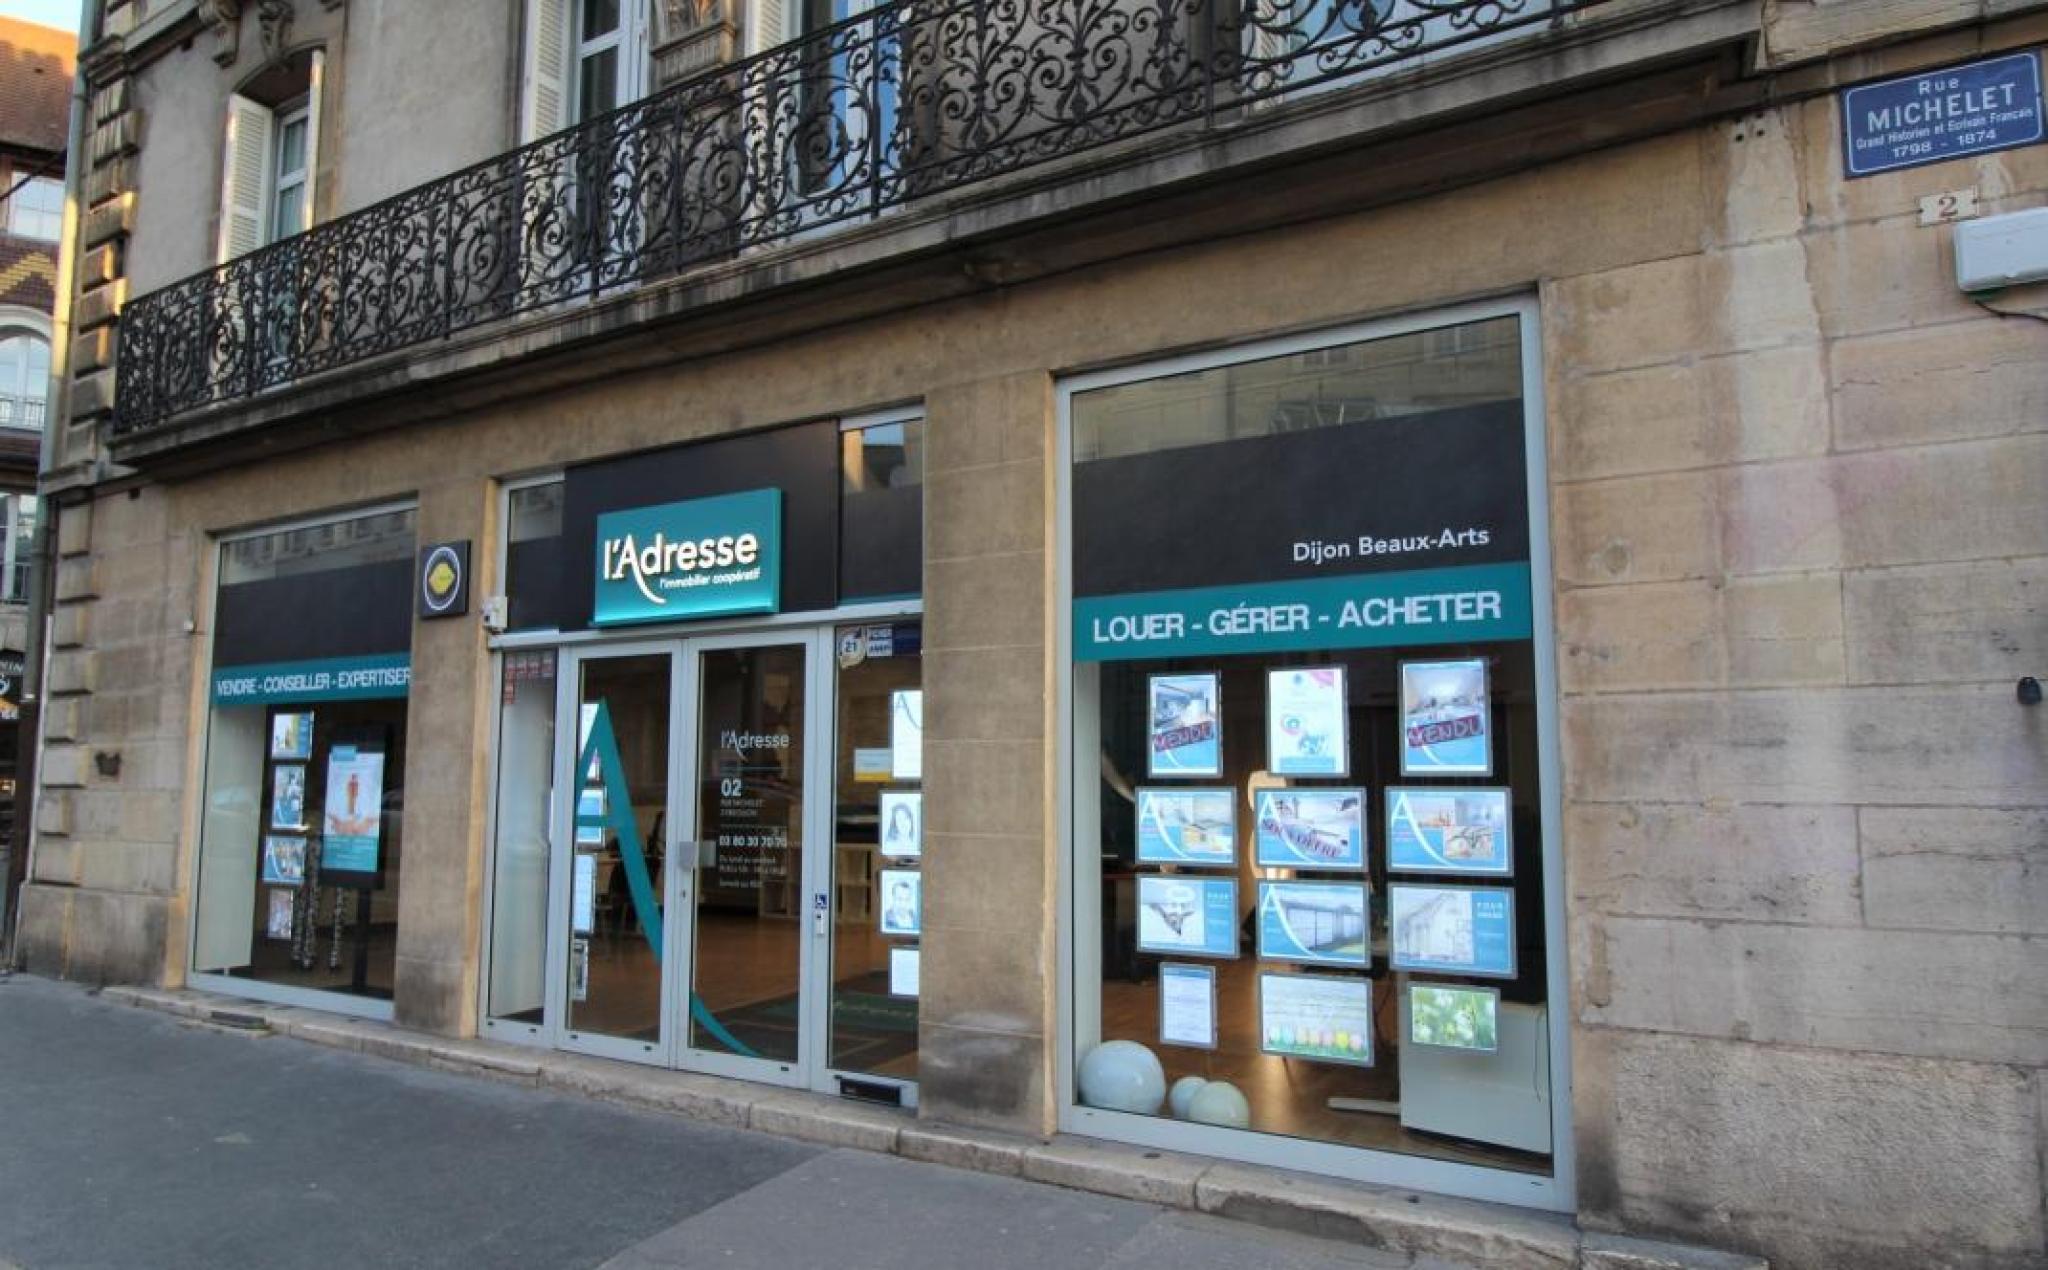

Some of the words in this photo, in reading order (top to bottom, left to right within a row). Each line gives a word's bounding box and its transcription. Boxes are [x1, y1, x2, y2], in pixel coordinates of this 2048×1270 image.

[1918, 78, 1959, 95] Rue
[1867, 83, 2016, 133] MICHELET
[1856, 136, 1884, 150] Grand
[1888, 128, 1930, 144] Historien
[1893, 141, 1932, 158] 1798
[1958, 129, 1997, 146] 1874
[1938, 196, 1959, 217] 2
[1293, 540, 1350, 565] Dijon
[1358, 527, 1491, 556] Beaux-Arts
[602, 532, 759, 602] l'Adresse
[1093, 613, 1185, 644] LOUER
[1208, 601, 1311, 636] GÉRER
[1338, 591, 1502, 629] ACHETER
[216, 678, 257, 696] VENDRE
[264, 672, 330, 694] CONSEILLER
[338, 666, 411, 689] EXPERTISER
[721, 778, 742, 797] 02
